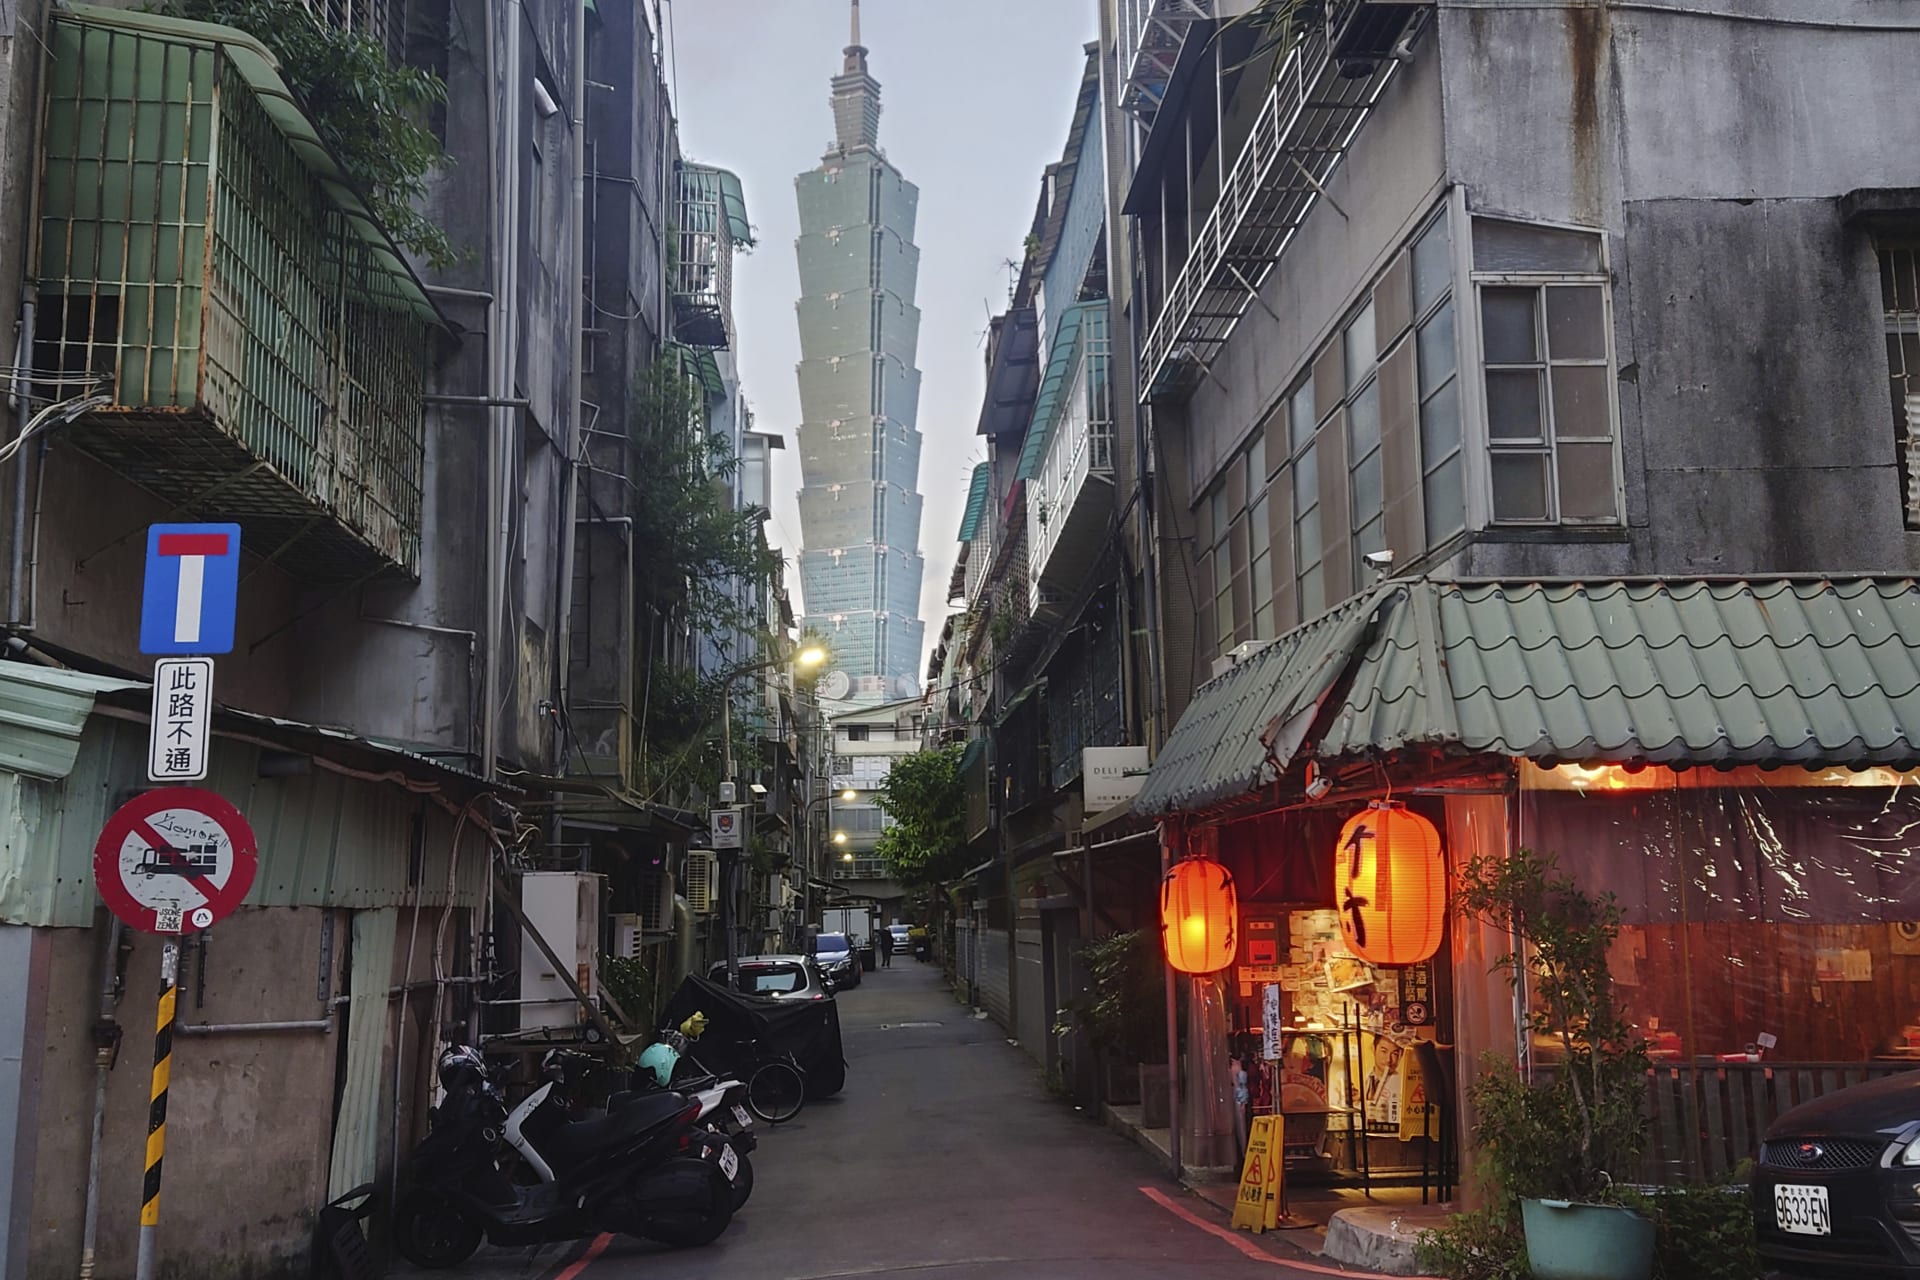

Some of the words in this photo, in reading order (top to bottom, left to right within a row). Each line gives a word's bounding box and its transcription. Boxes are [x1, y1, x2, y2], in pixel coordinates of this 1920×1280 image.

[165, 666, 196, 773] 此路不通
[1094, 767, 1118, 775] DELI
